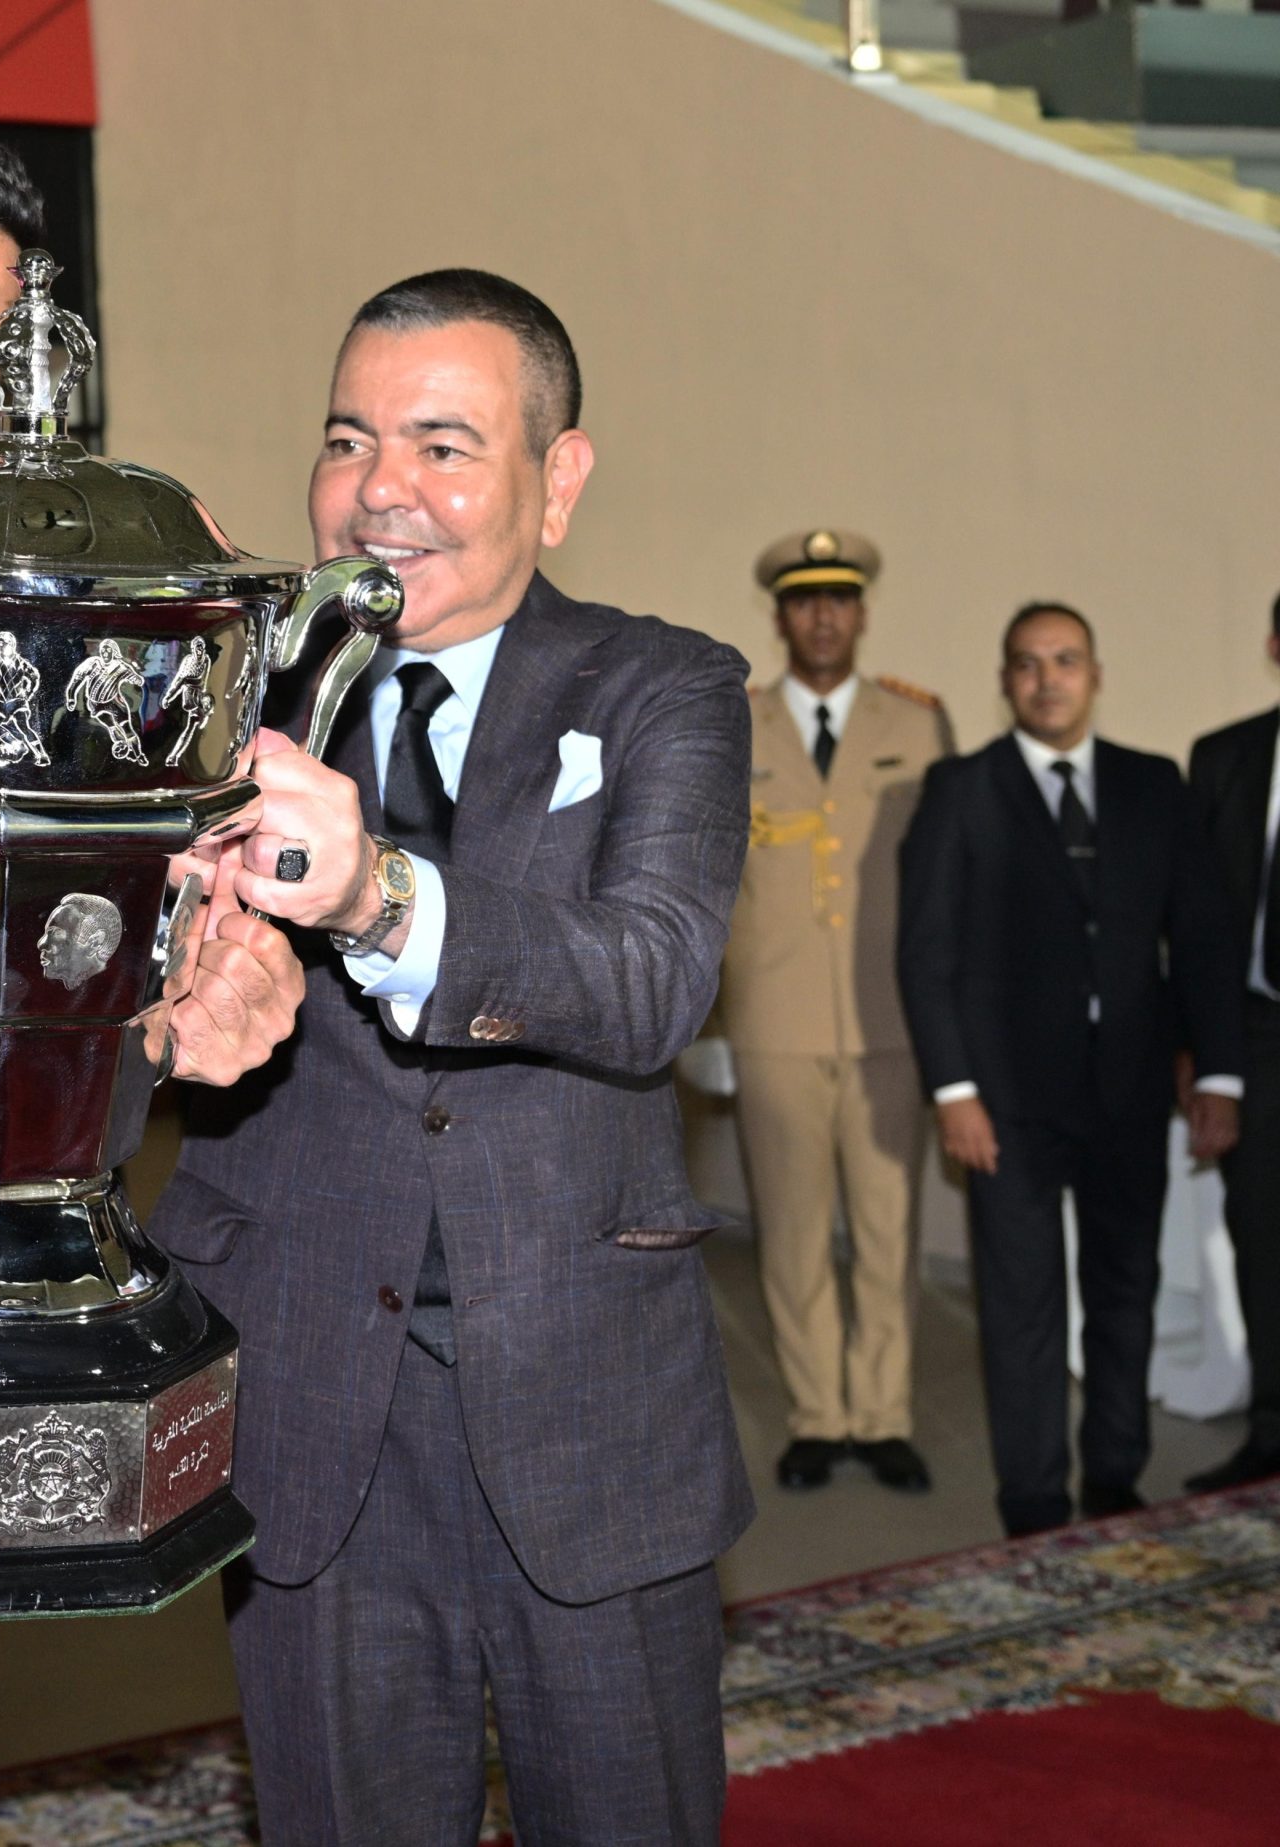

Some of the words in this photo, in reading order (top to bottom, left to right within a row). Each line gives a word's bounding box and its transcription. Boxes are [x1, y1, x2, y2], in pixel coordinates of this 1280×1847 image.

[204, 1390, 229, 1416] الجامعة
[179, 1405, 202, 1435] الملكية
[152, 1420, 179, 1451] المغربية
[190, 1440, 209, 1471] لكرة
